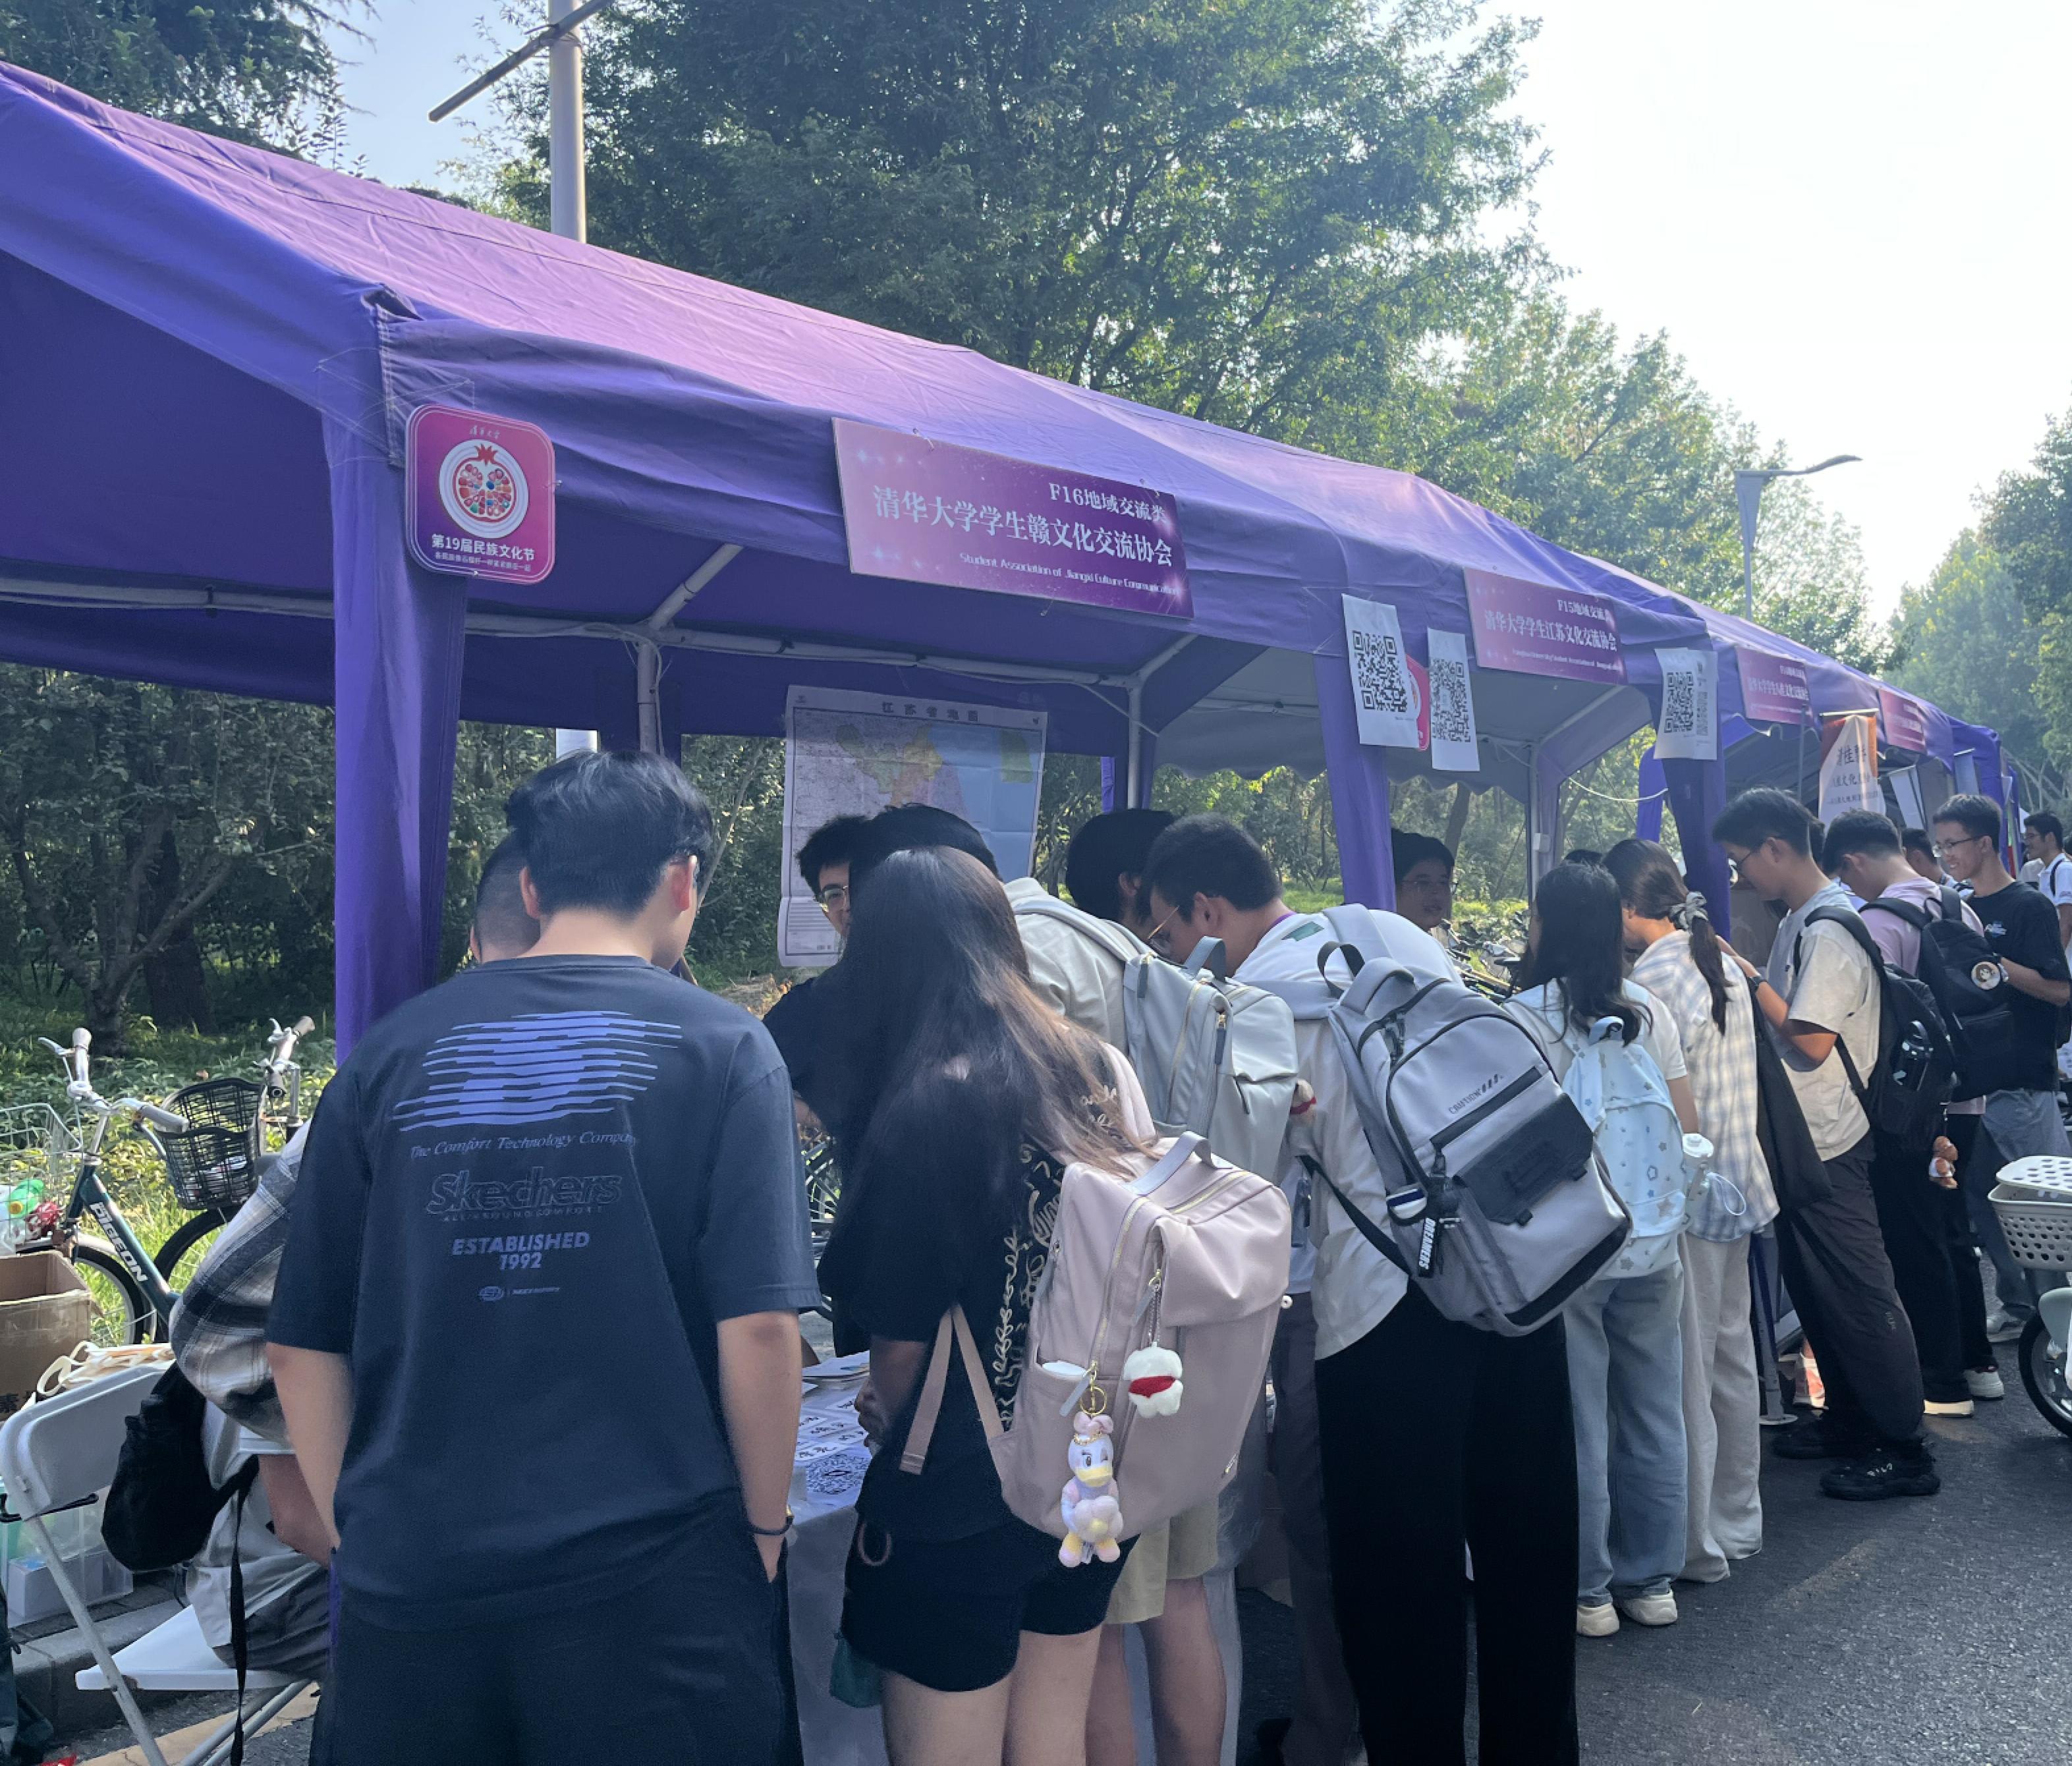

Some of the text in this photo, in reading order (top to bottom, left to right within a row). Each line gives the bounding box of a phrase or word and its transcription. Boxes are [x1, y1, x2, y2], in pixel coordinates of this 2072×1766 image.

[874, 485, 1173, 567] 清华大学学生赣文化交流协会
[432, 533, 536, 561] 第19届民族文化节
[452, 1232, 590, 1256] ESTABLISHED
[499, 1252, 542, 1270] 1992
